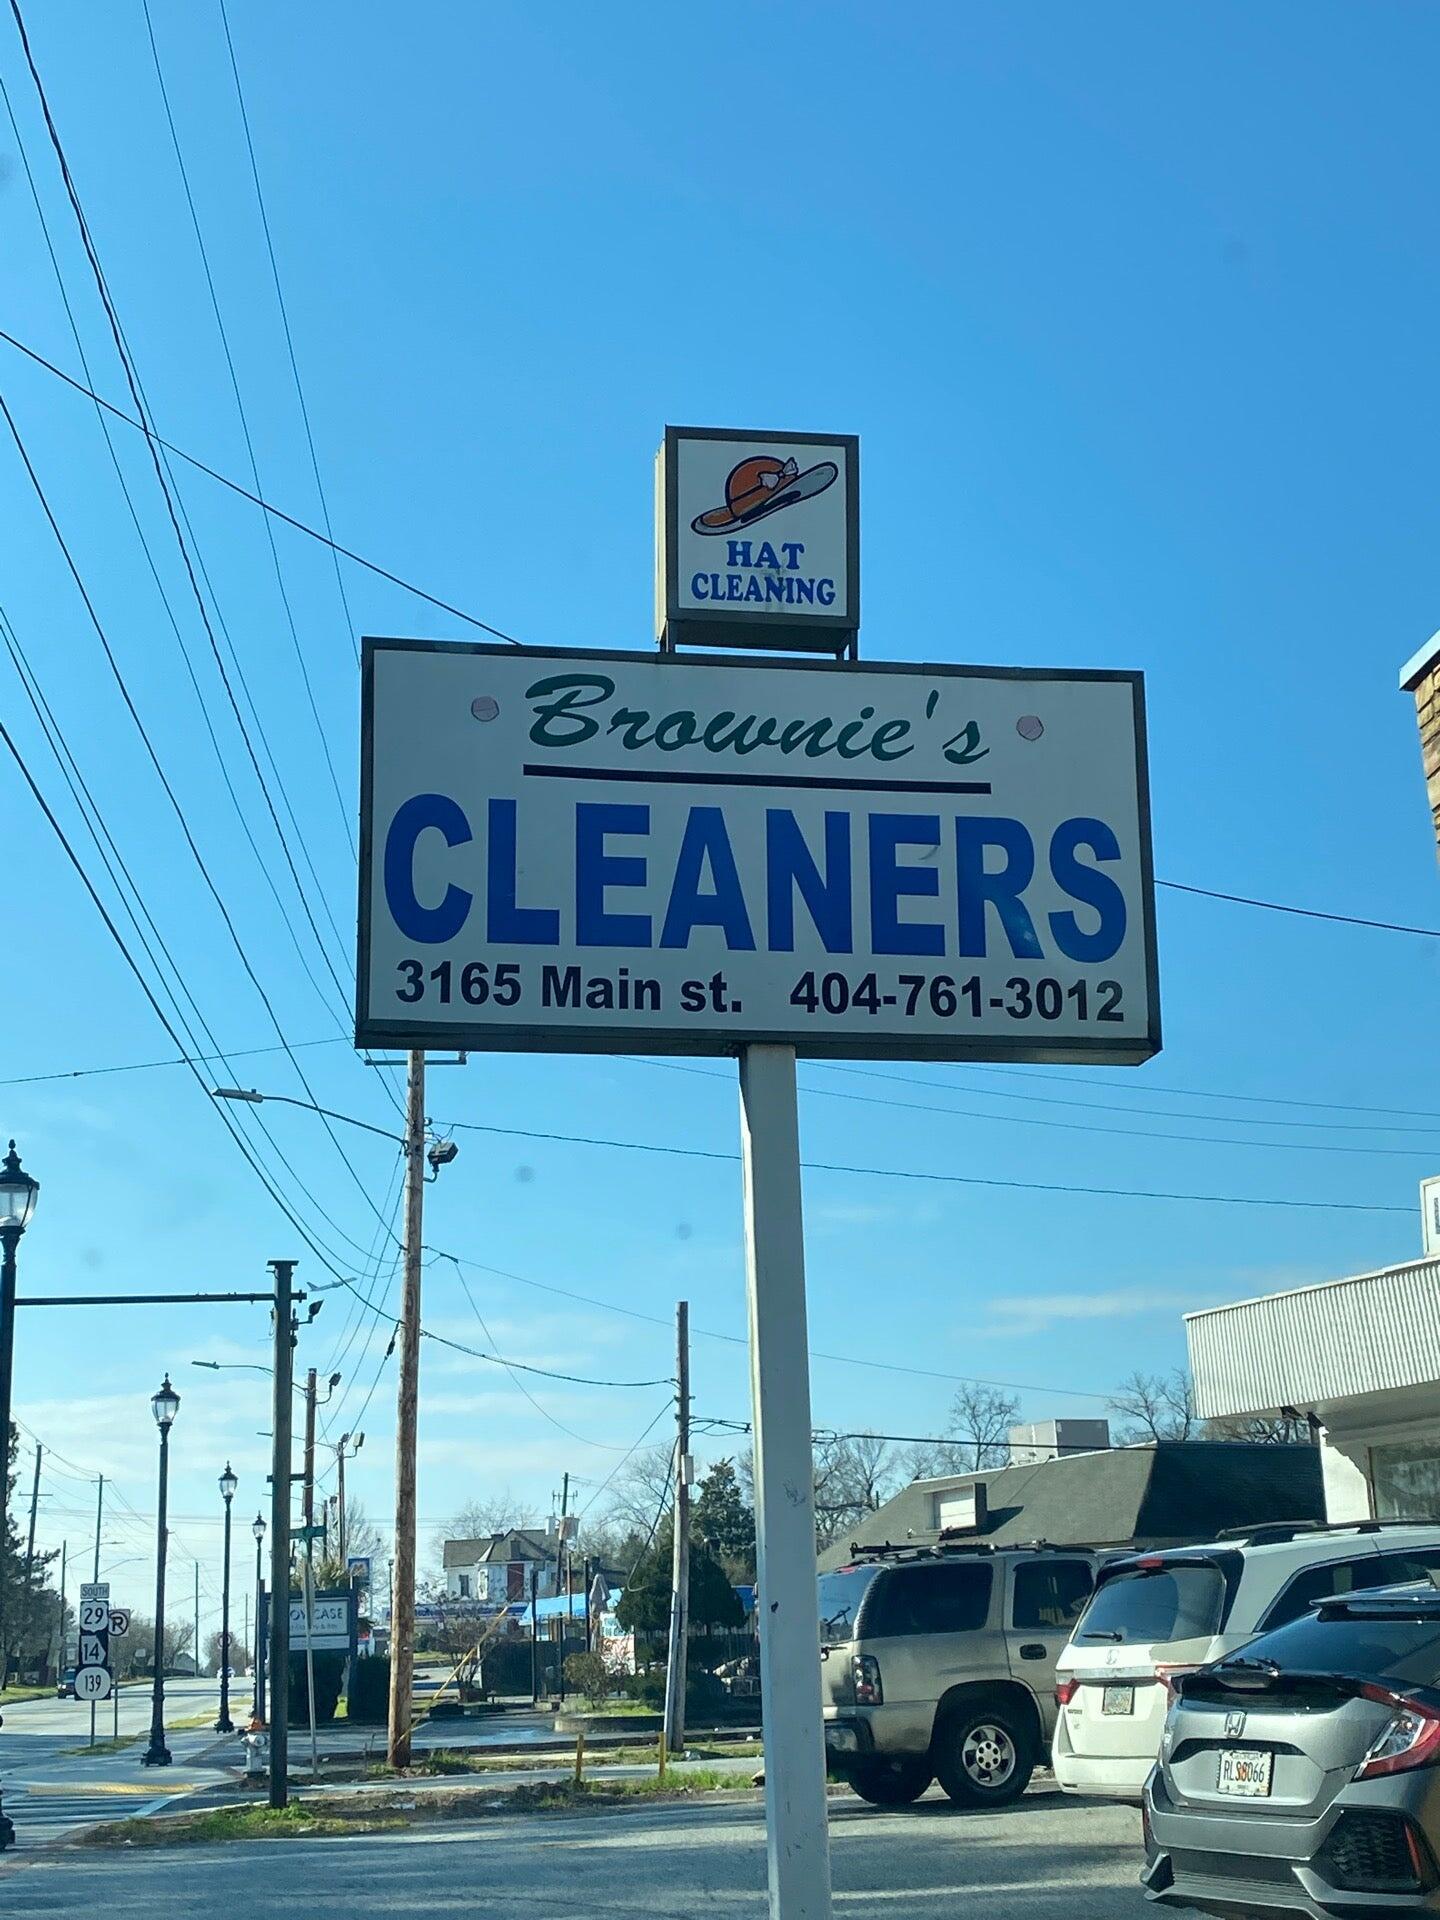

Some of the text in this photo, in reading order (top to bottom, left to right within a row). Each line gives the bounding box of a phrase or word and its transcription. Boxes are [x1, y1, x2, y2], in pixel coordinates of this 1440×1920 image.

[726, 540, 805, 570] HAT
[690, 572, 836, 606] CLEANING
[523, 673, 992, 766] Brownie's
[383, 793, 1127, 964] CLEANERS
[395, 959, 1125, 1022] 3165 Main st. 404-761-3012
[82, 1586, 109, 1598] SOUTH
[84, 1607, 104, 1625] 29
[83, 1643, 100, 1661] 14
[84, 1674, 102, 1693] 139
